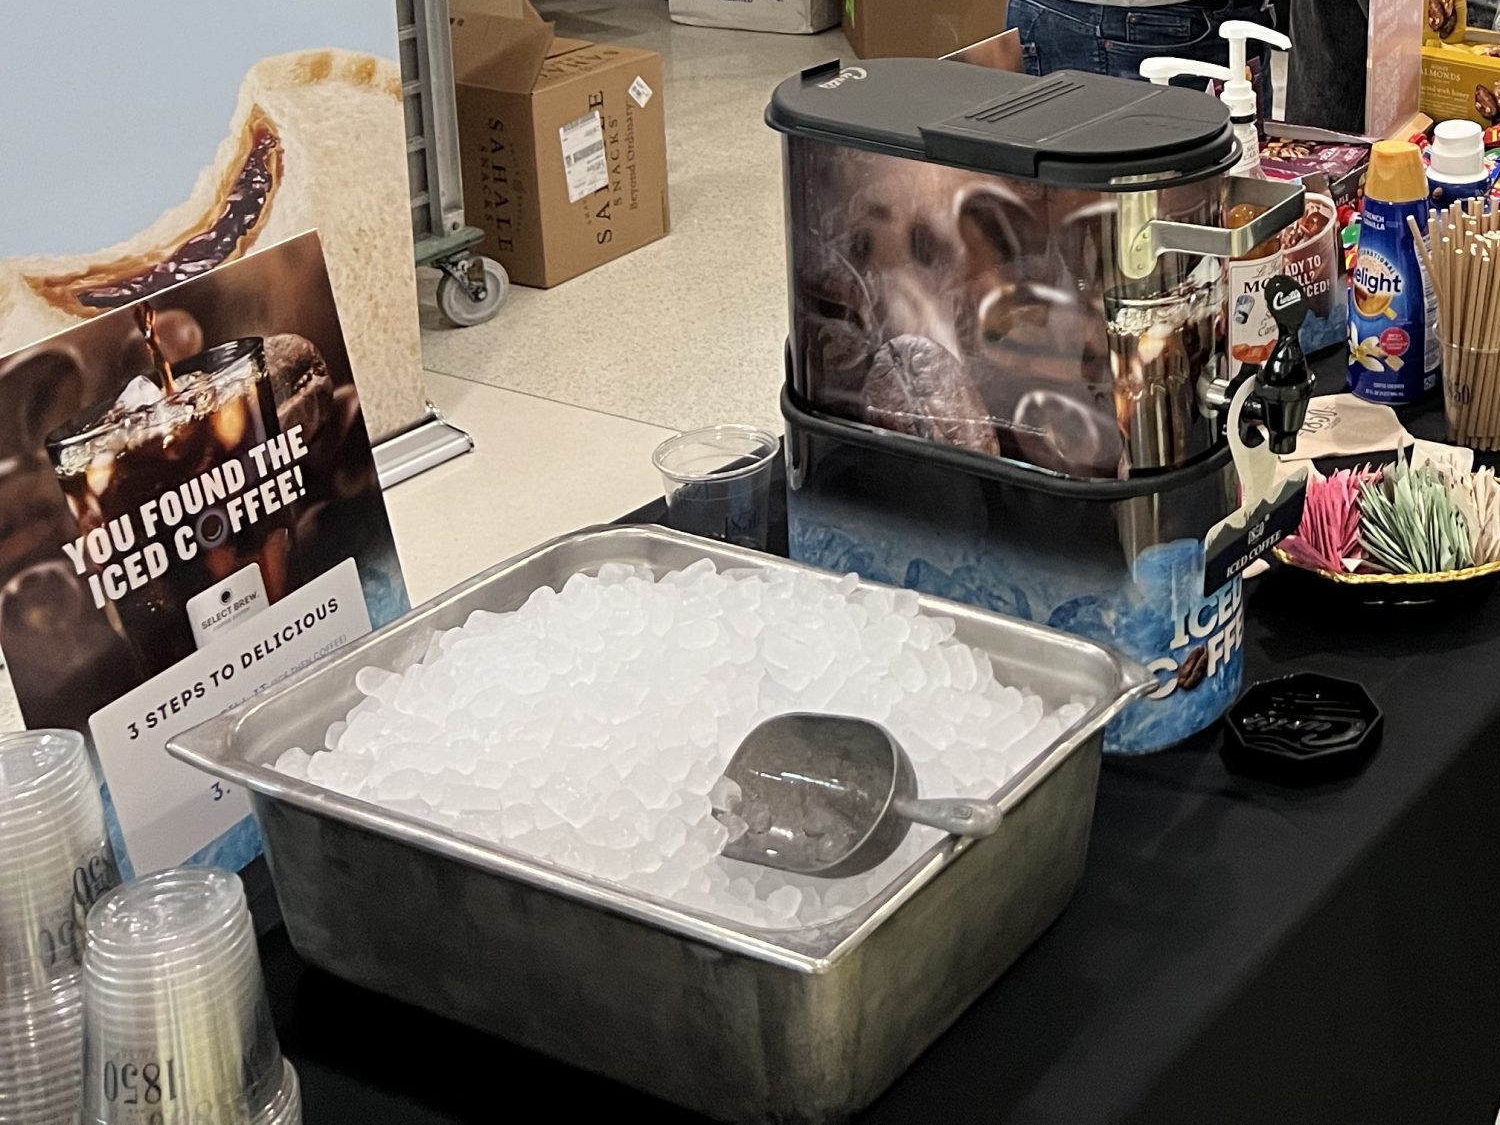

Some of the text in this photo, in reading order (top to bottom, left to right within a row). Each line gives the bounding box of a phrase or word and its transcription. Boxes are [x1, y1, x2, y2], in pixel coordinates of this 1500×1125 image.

[1307, 255, 1321, 268] TO
[62, 424, 310, 576] YOU FOUND THE
[1249, 530, 1282, 560] COFFEE
[88, 542, 170, 610] ICED
[201, 606, 233, 630] SELECT
[127, 722, 140, 740] 3
[145, 681, 207, 729] STEPS
[209, 663, 235, 689] TO
[241, 598, 340, 670] DELICIOUS
